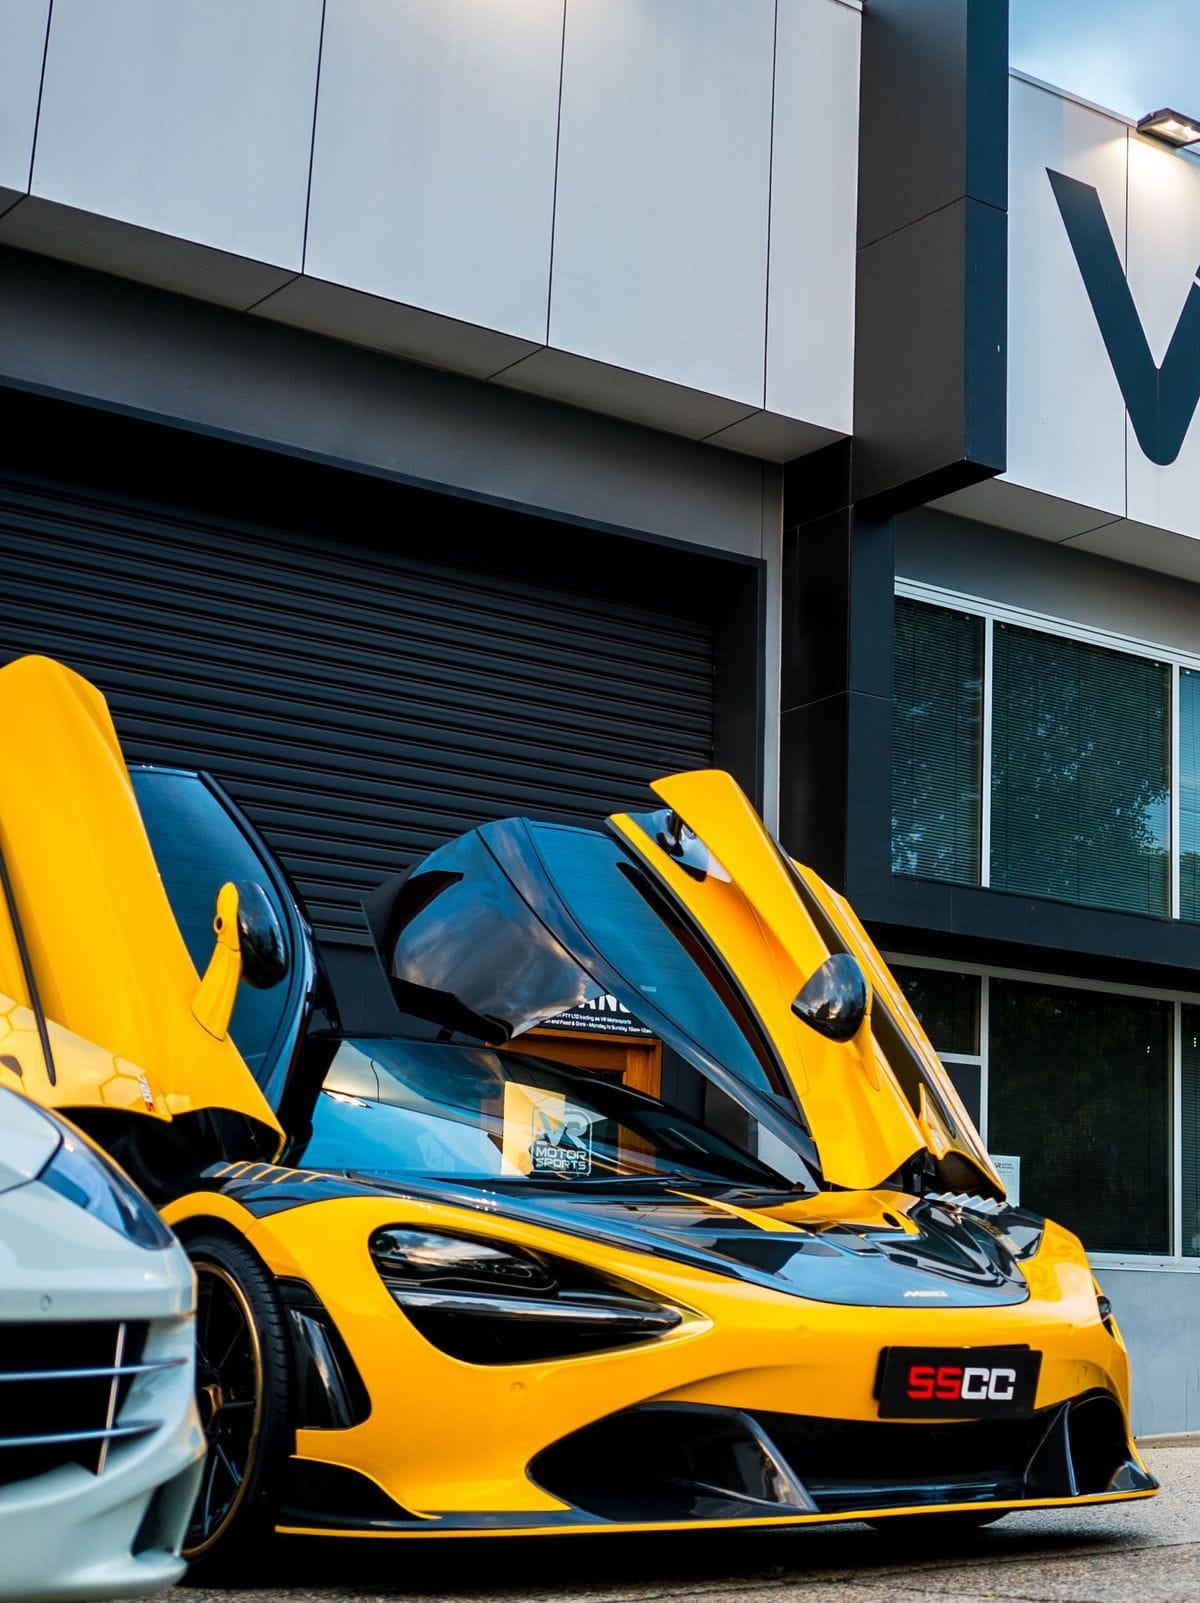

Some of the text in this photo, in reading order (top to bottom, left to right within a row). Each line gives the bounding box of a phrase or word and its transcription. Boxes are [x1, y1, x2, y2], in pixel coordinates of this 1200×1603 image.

[540, 1111, 588, 1149] VR
[535, 1146, 587, 1161] MOTOR
[535, 1157, 587, 1170] SPORTS
[907, 1365, 1017, 1401] SSCC
